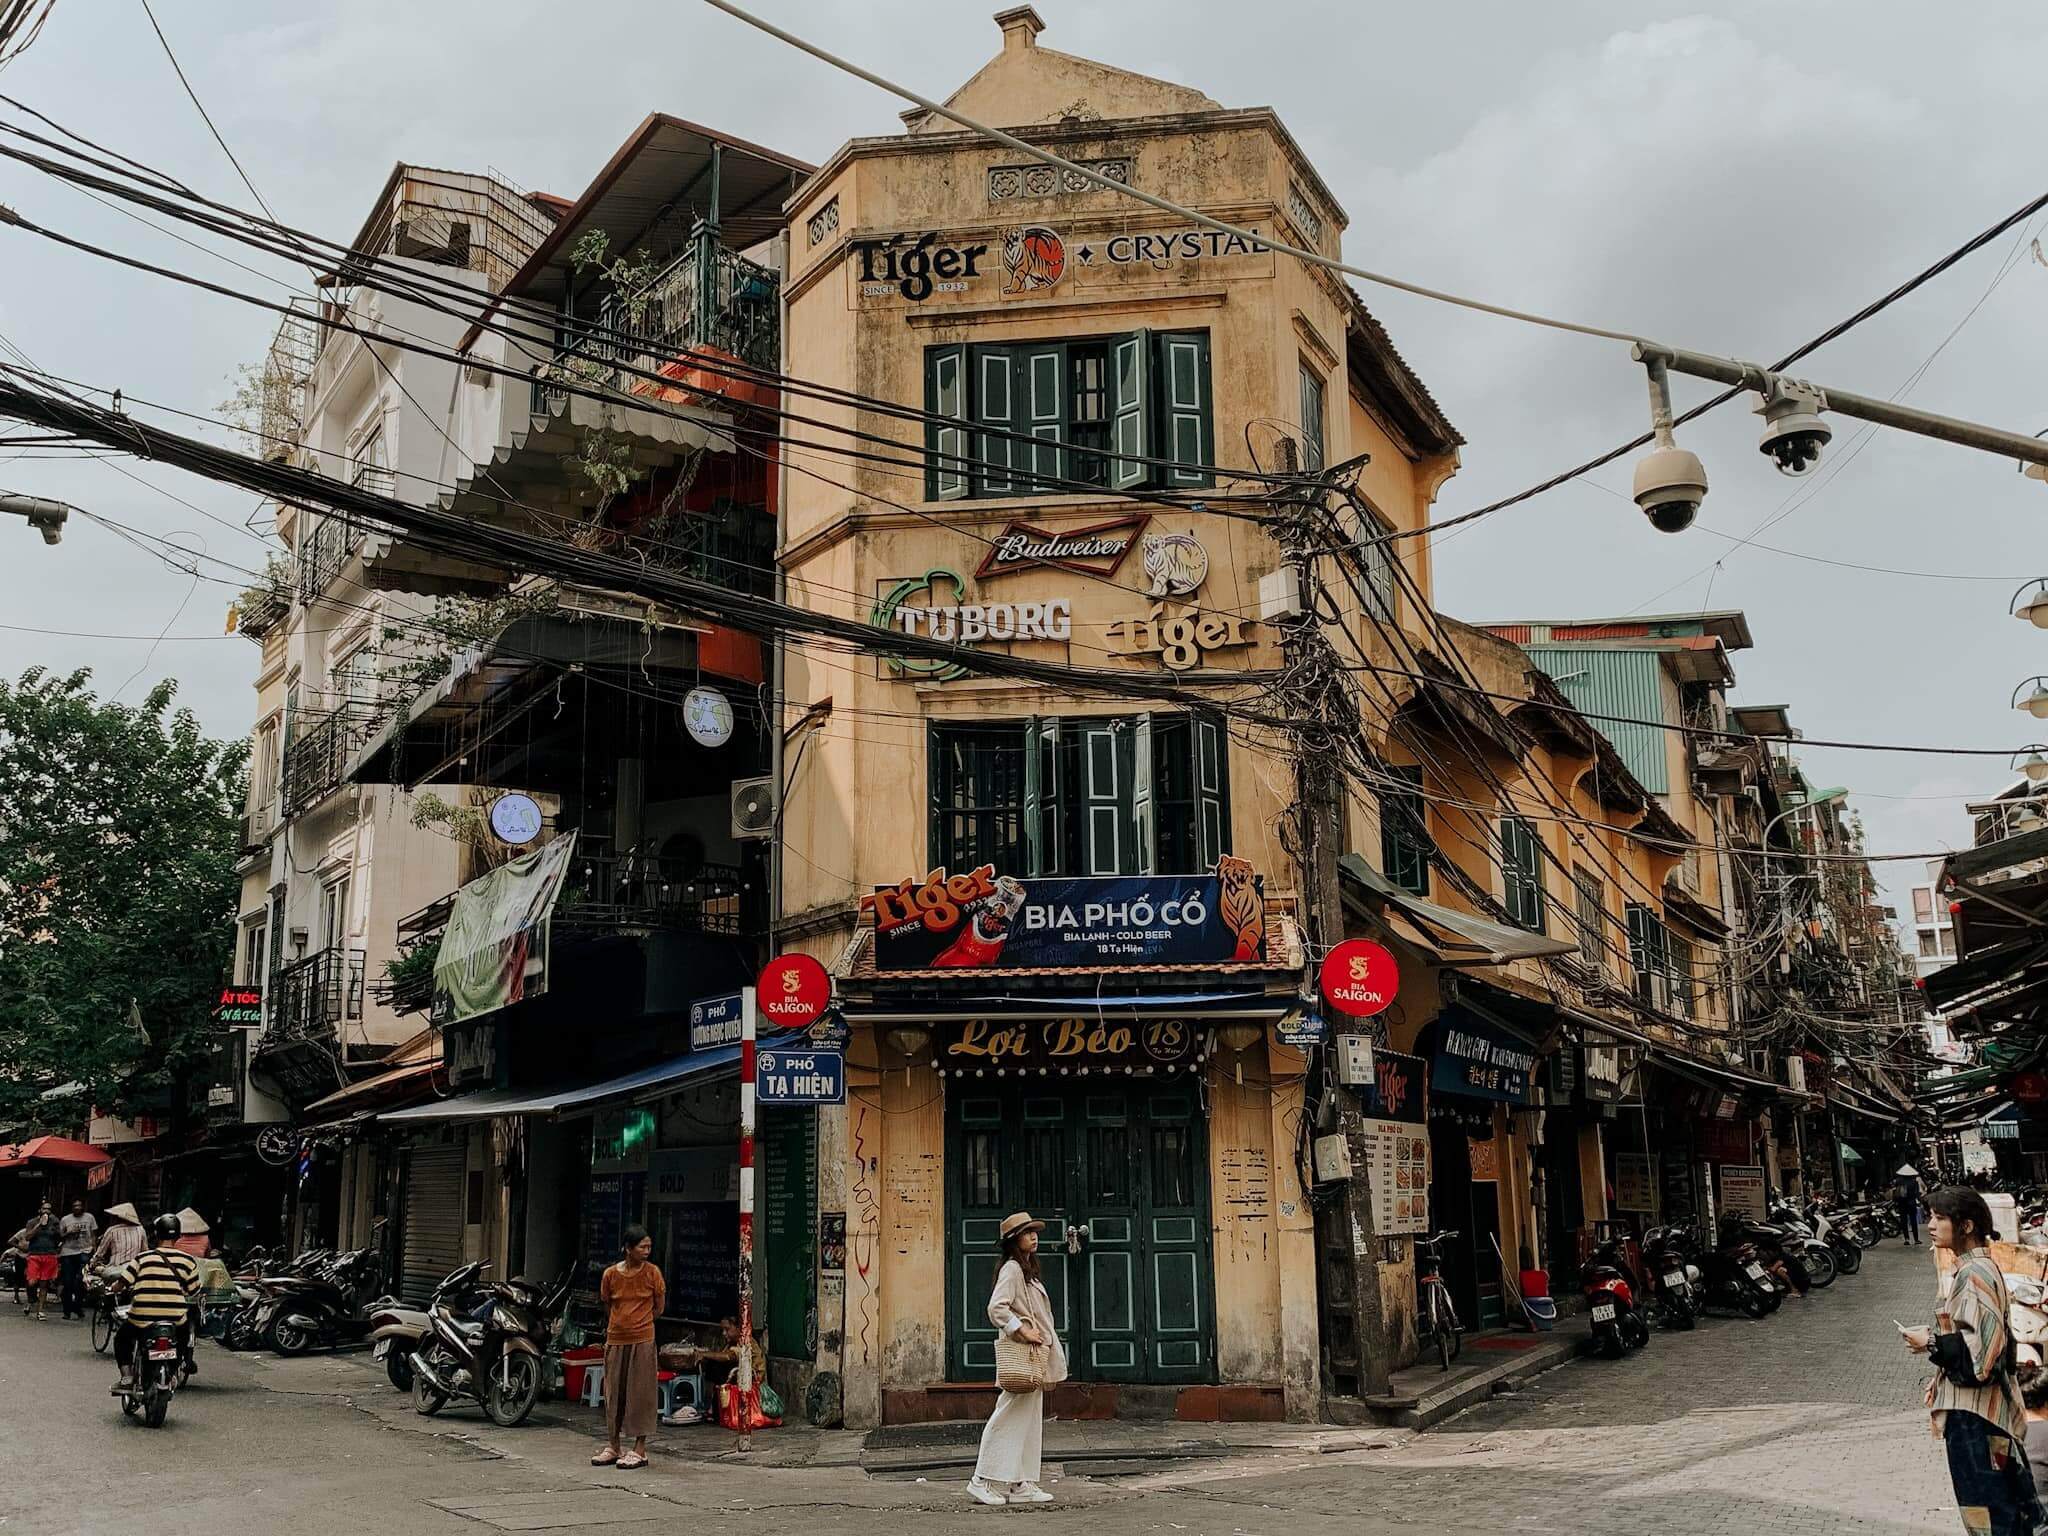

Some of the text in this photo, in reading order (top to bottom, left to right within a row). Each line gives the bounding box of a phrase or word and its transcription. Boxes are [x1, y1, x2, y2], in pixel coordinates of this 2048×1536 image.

[1107, 230, 1273, 263] CRYSTAL
[854, 234, 988, 299] Tiger
[864, 281, 968, 295] SINCE 1932
[993, 534, 1128, 561] Budweiser
[896, 600, 1071, 641] TUBORG
[1106, 602, 1250, 670] Tiger
[861, 865, 997, 932] Tiger
[1025, 890, 1206, 929] BIA PHỐ CỔ
[889, 921, 921, 937] SINCE
[1064, 933, 1081, 941] BIA
[1082, 932, 1110, 943] LẠNH
[1116, 931, 1143, 940] COLD
[1145, 931, 1172, 940] BEER
[1097, 943, 1144, 954] 18 Tạ Hiện
[1333, 988, 1382, 1002] SAIGON
[1350, 982, 1365, 991] BIA
[708, 1001, 726, 1018] PHỐ
[769, 1003, 814, 1014] SAIGON
[948, 1018, 1031, 1064] Lợi
[1149, 1020, 1182, 1046] 18
[786, 1055, 815, 1071] PHỐ
[766, 1071, 834, 1098] TẠ HIỆN
[1375, 1061, 1408, 1114] Tiger
